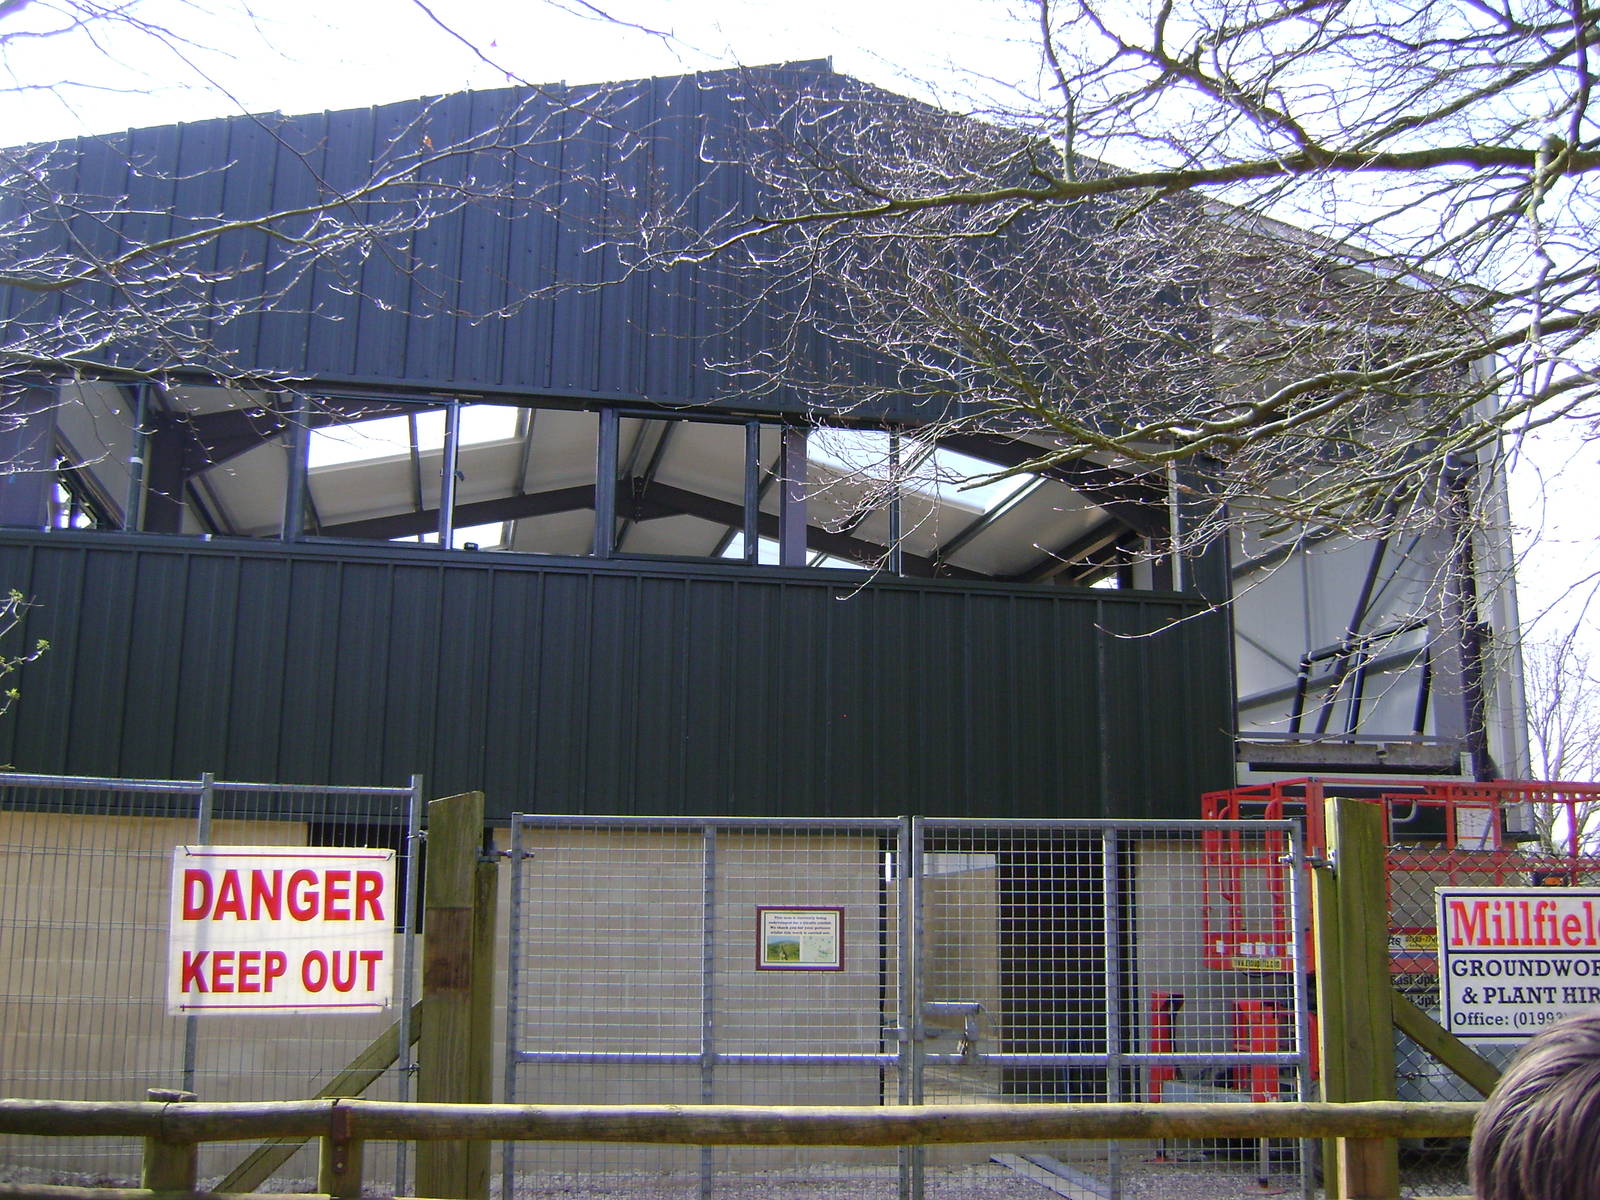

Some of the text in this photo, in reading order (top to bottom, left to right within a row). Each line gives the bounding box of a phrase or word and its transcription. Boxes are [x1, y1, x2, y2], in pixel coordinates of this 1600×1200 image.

[183, 869, 384, 921] DANGER
[1450, 900, 1600, 946] Millfiel
[181, 950, 384, 993] KEEP OUT
[1462, 986, 1478, 1004] &
[1483, 986, 1557, 1004] PLANT
[1453, 1011, 1567, 1028] Office: (0199
